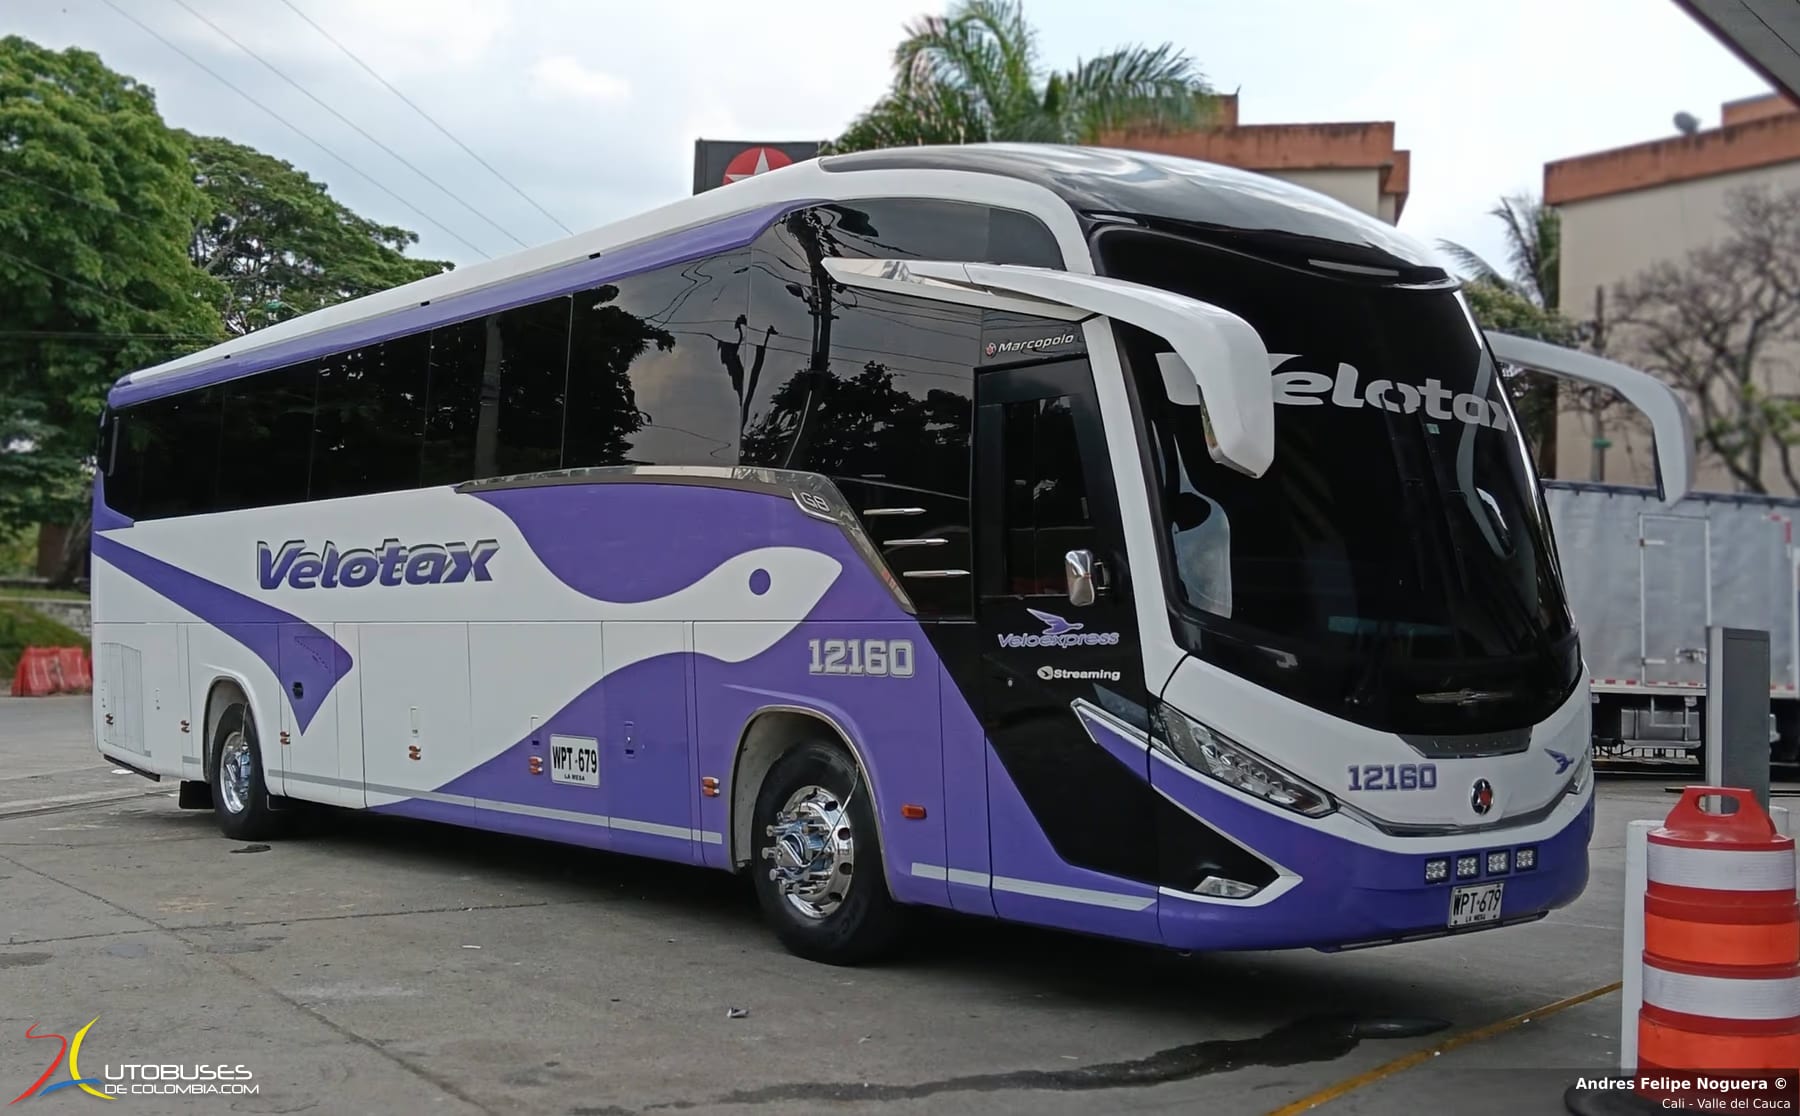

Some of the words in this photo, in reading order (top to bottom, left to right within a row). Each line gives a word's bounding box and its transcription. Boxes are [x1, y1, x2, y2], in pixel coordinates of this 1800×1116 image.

[999, 334, 1074, 352] Marcopolo
[256, 538, 500, 590] Velotax
[998, 632, 1120, 648] Veloexpress
[809, 638, 915, 678] 12160
[1054, 669, 1121, 681] Streaming
[1348, 763, 1438, 791] 12160
